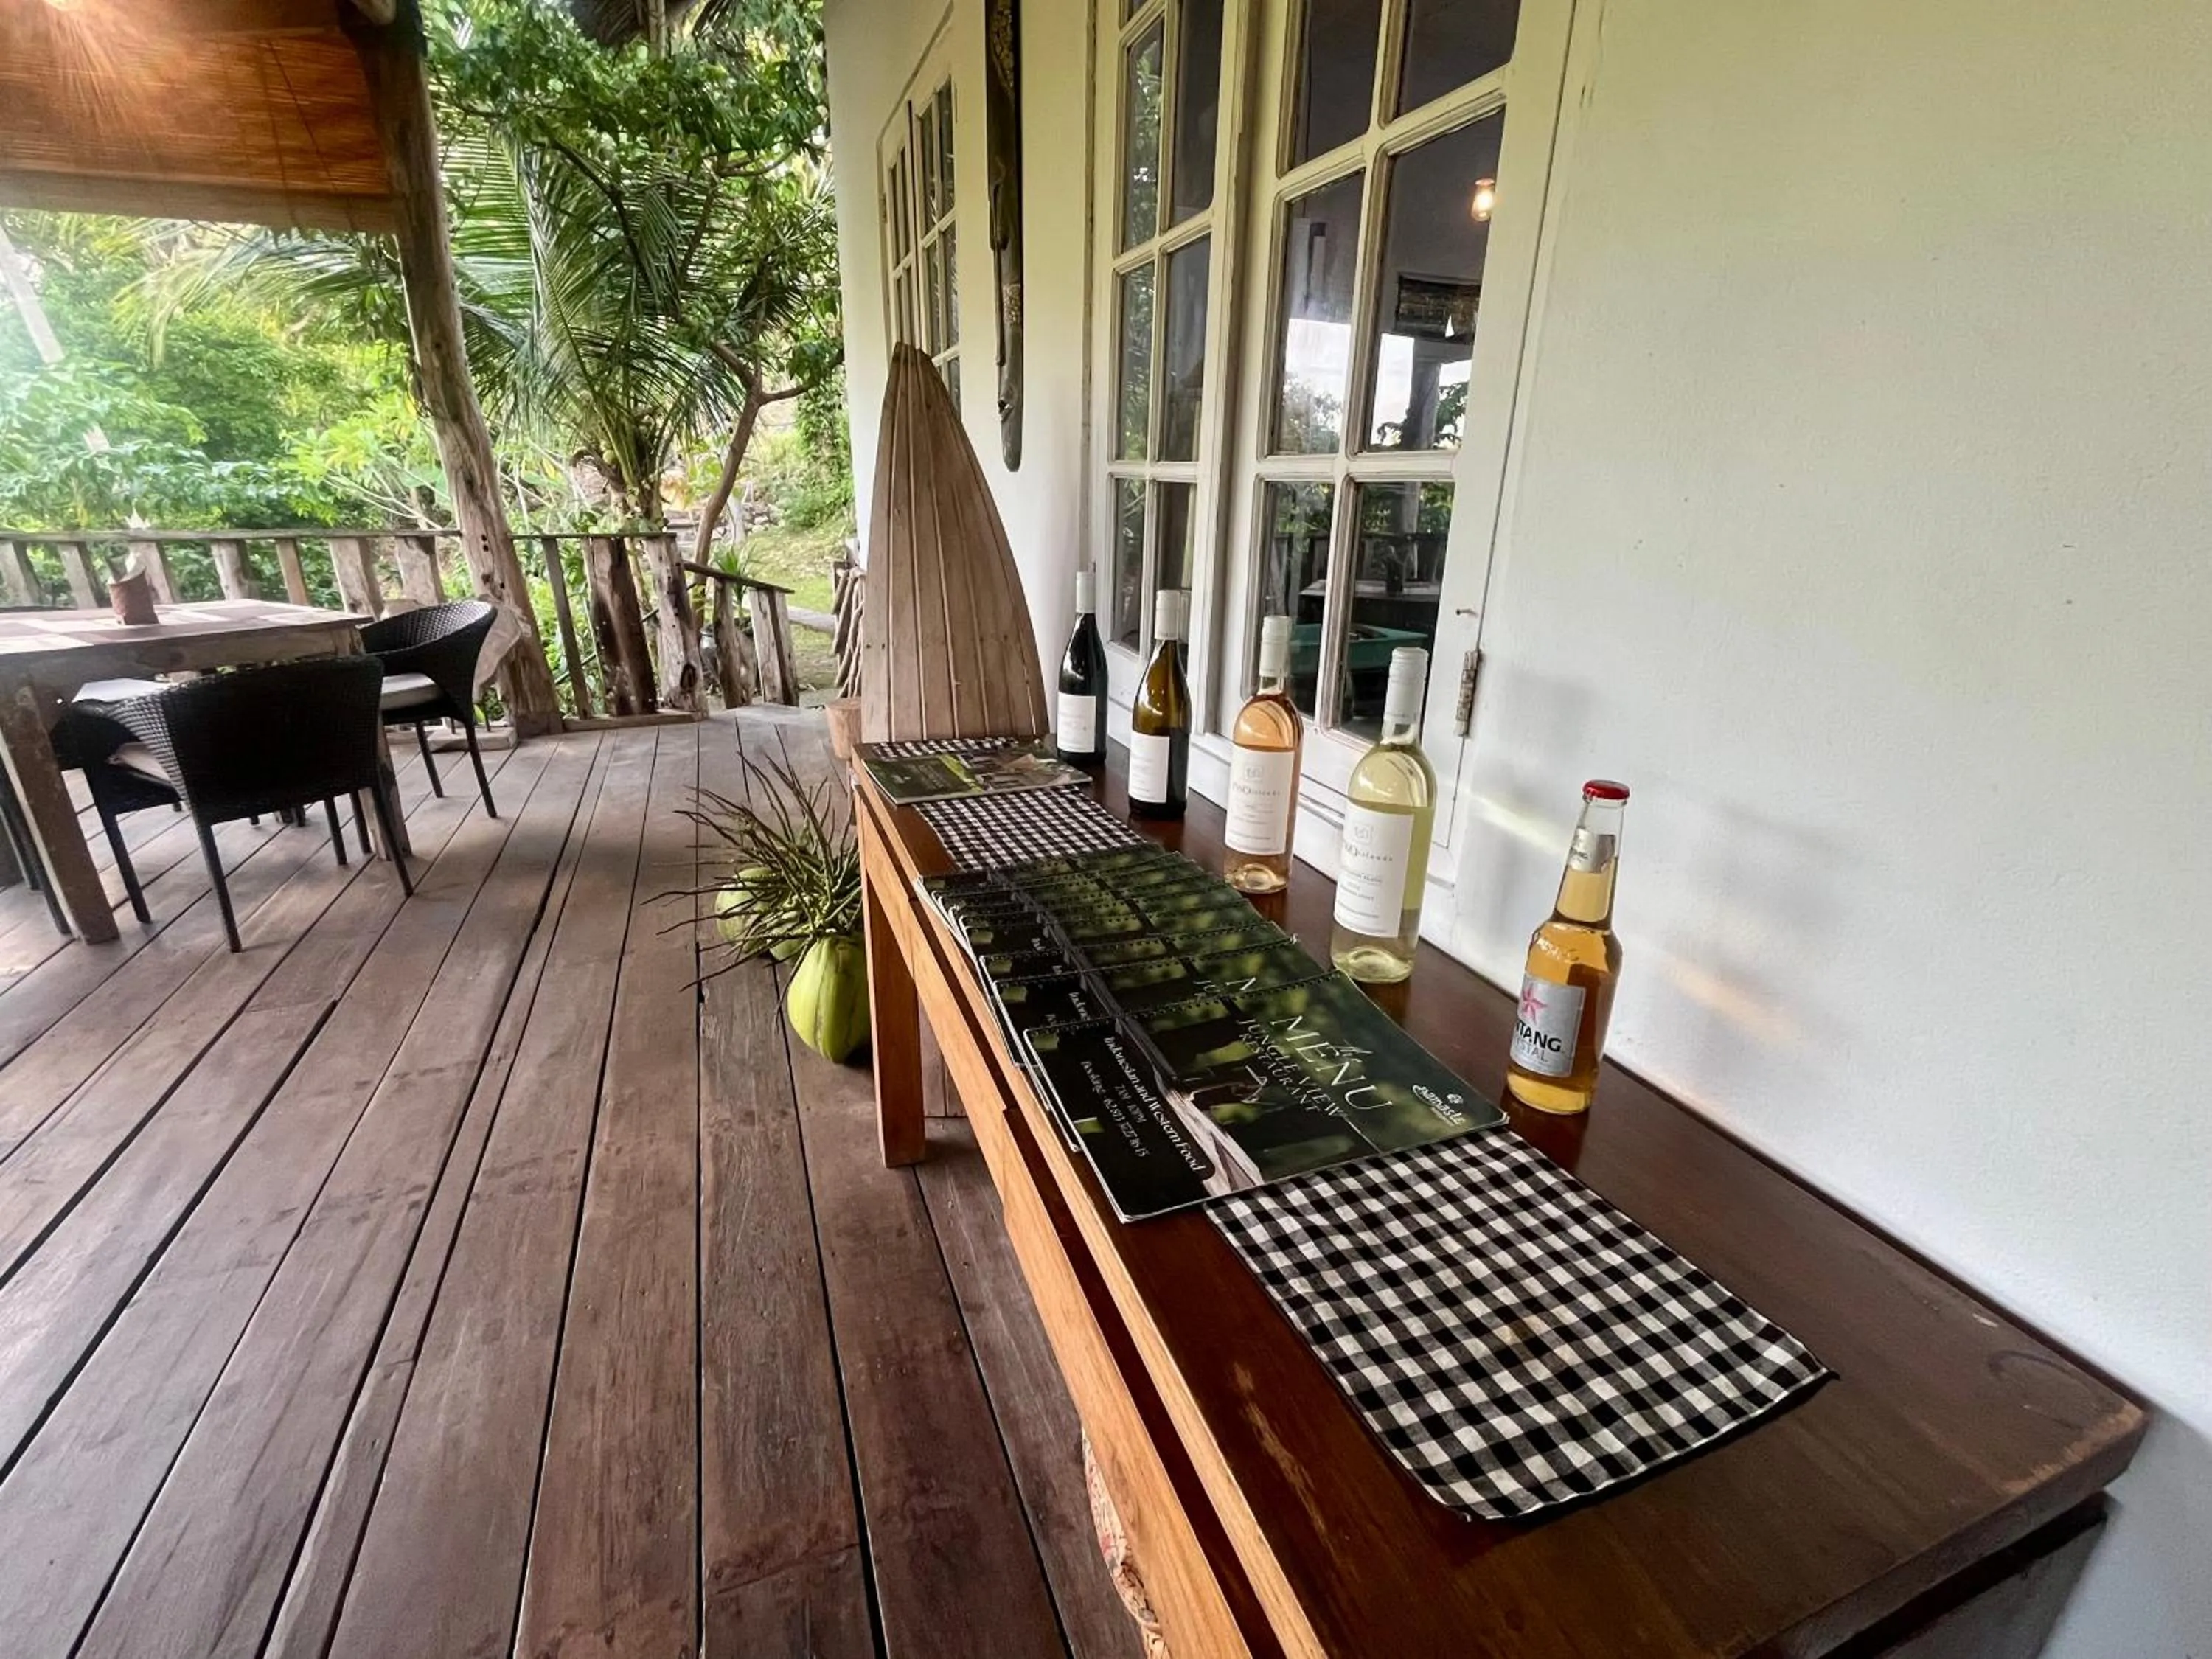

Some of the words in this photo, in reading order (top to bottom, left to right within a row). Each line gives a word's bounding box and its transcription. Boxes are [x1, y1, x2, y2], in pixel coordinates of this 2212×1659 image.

[1237, 1019, 1301, 1073] JUNGLE
[1298, 1077, 1346, 1116] VIEW
[1239, 1034, 1321, 1113] RESTAURANT
[1269, 1015, 1393, 1110] MENU
[1134, 1083, 1157, 1102] and
[1147, 1102, 1184, 1142] Western
[1177, 1142, 1207, 1172] Food
